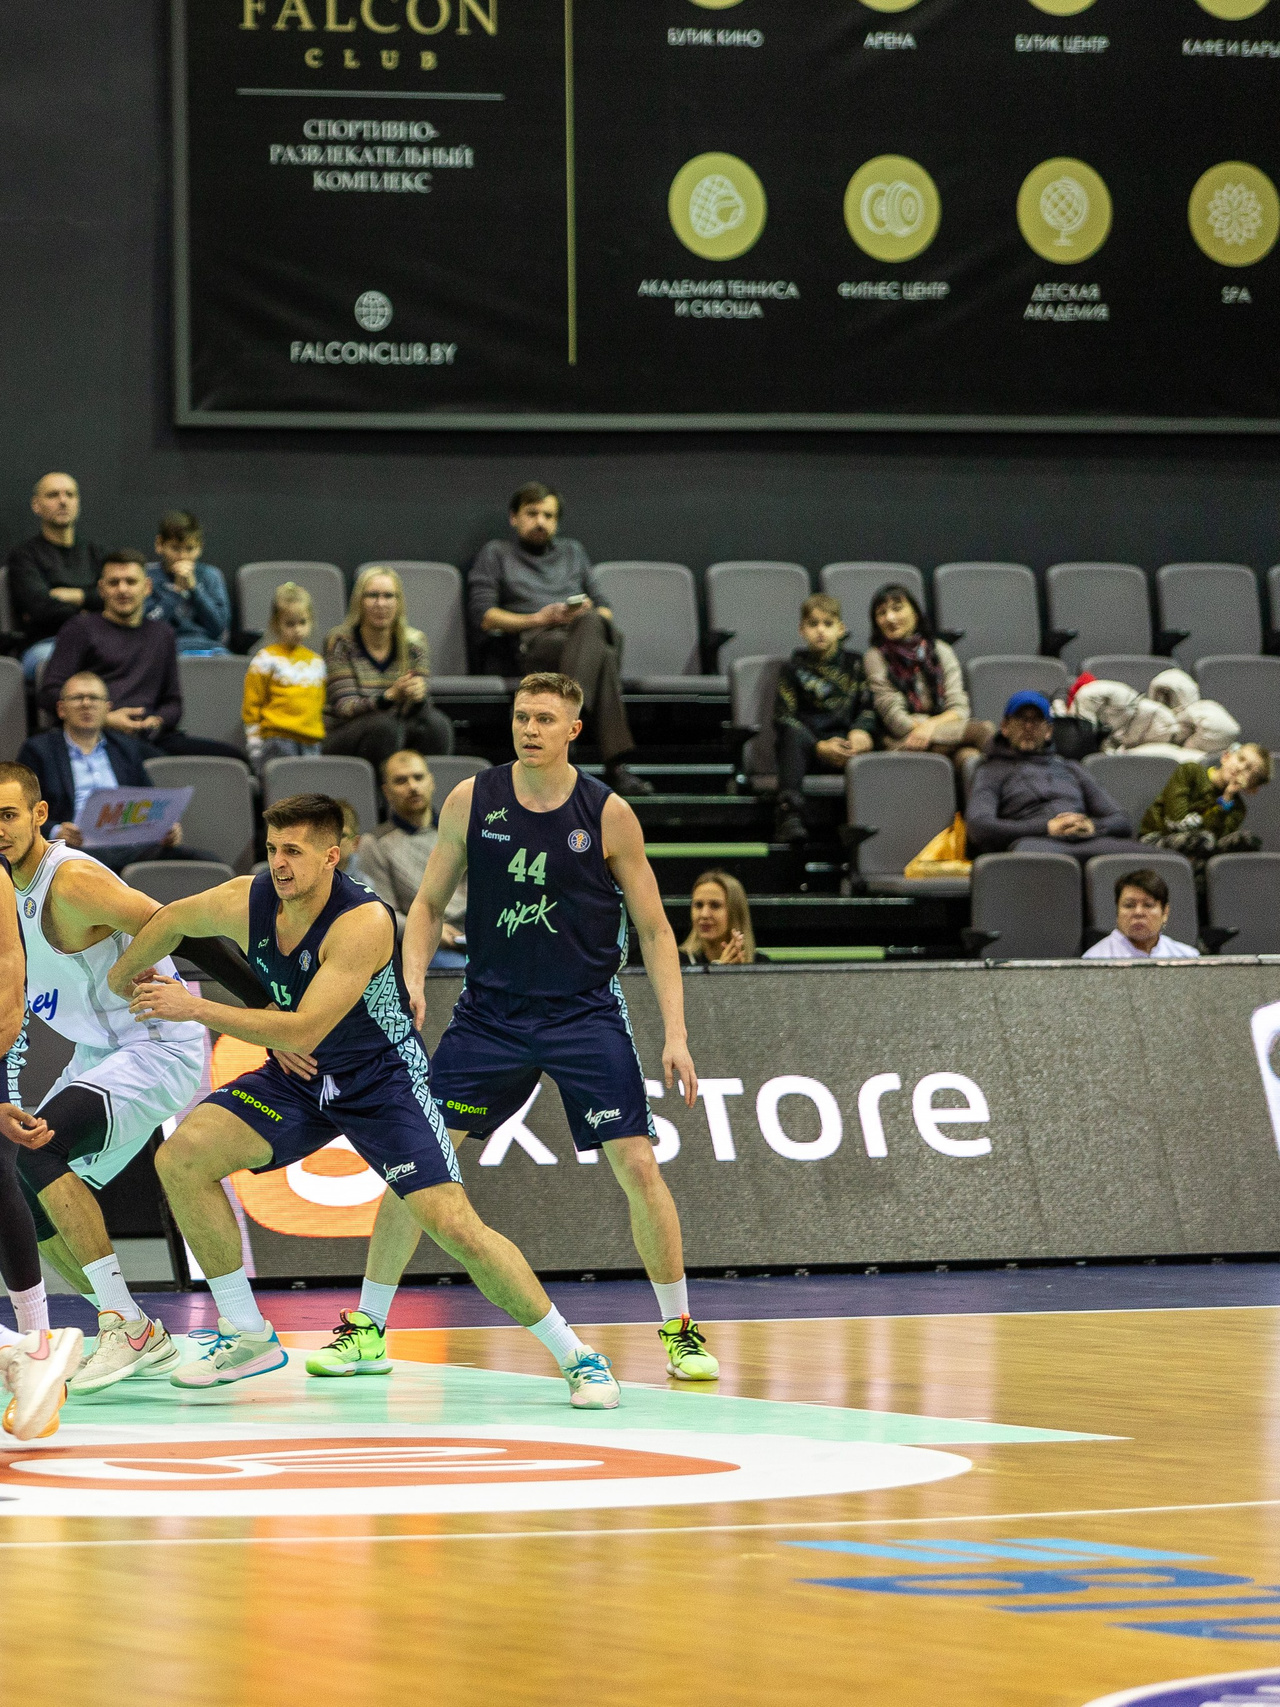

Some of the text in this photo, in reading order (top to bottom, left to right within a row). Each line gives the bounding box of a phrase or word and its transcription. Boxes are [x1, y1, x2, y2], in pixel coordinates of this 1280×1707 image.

[238, 0, 499, 36] FALCON
[667, 27, 765, 48] БУТИК КИНО
[863, 31, 918, 50] АРЕНА
[303, 48, 438, 71] CLUB
[303, 118, 440, 142] СПОРТИВНО-
[269, 143, 475, 168] РАЗВЛЕКАТЕЛЬНЫЙ
[312, 170, 433, 193] КОМПЛЕКС
[637, 279, 801, 300] АКАДЕМИЯ ТЕННИСА
[837, 281, 951, 301] ФИТНЕС ЦЕНТР
[1030, 283, 1102, 302] ДЕТСКАЯ
[1221, 285, 1253, 304] SPA
[690, 299, 765, 319] СКВОША
[1022, 302, 1110, 322] АКАДЕМИЯ
[290, 341, 458, 365] FALCONCLUB.BY
[481, 828, 511, 842] Kempa
[507, 847, 548, 885] 44
[270, 980, 292, 1006] 15
[231, 1088, 283, 1122] евроопт
